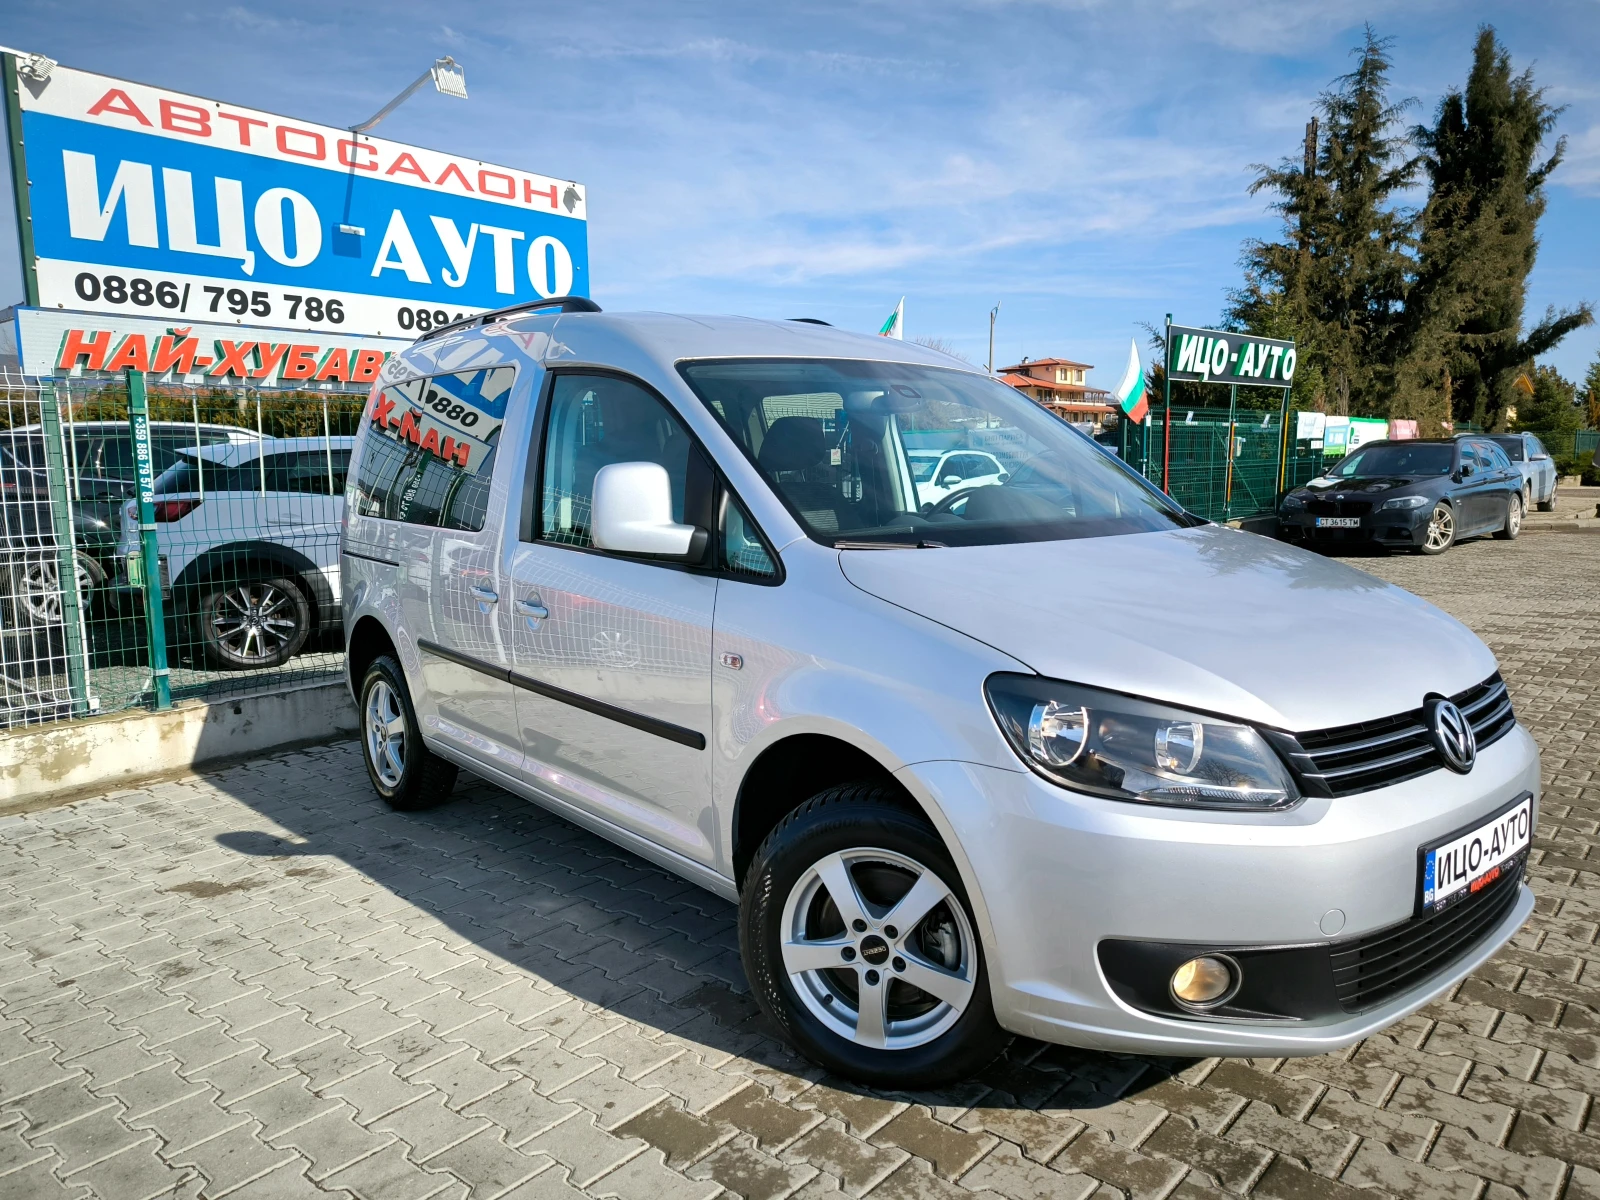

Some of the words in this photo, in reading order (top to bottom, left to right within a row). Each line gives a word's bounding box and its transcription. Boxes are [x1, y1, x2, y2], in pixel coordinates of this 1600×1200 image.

[87, 88, 558, 209] АВТОСАЛОН
[74, 271, 190, 314] 0886/
[203, 285, 271, 318] 795
[283, 293, 345, 325] 786
[56, 326, 396, 384] НАЙ-ХУБАВ
[136, 442, 149, 461] 886
[1438, 807, 1528, 890] ИЦО-АУТО
[1424, 887, 1434, 904] BG
